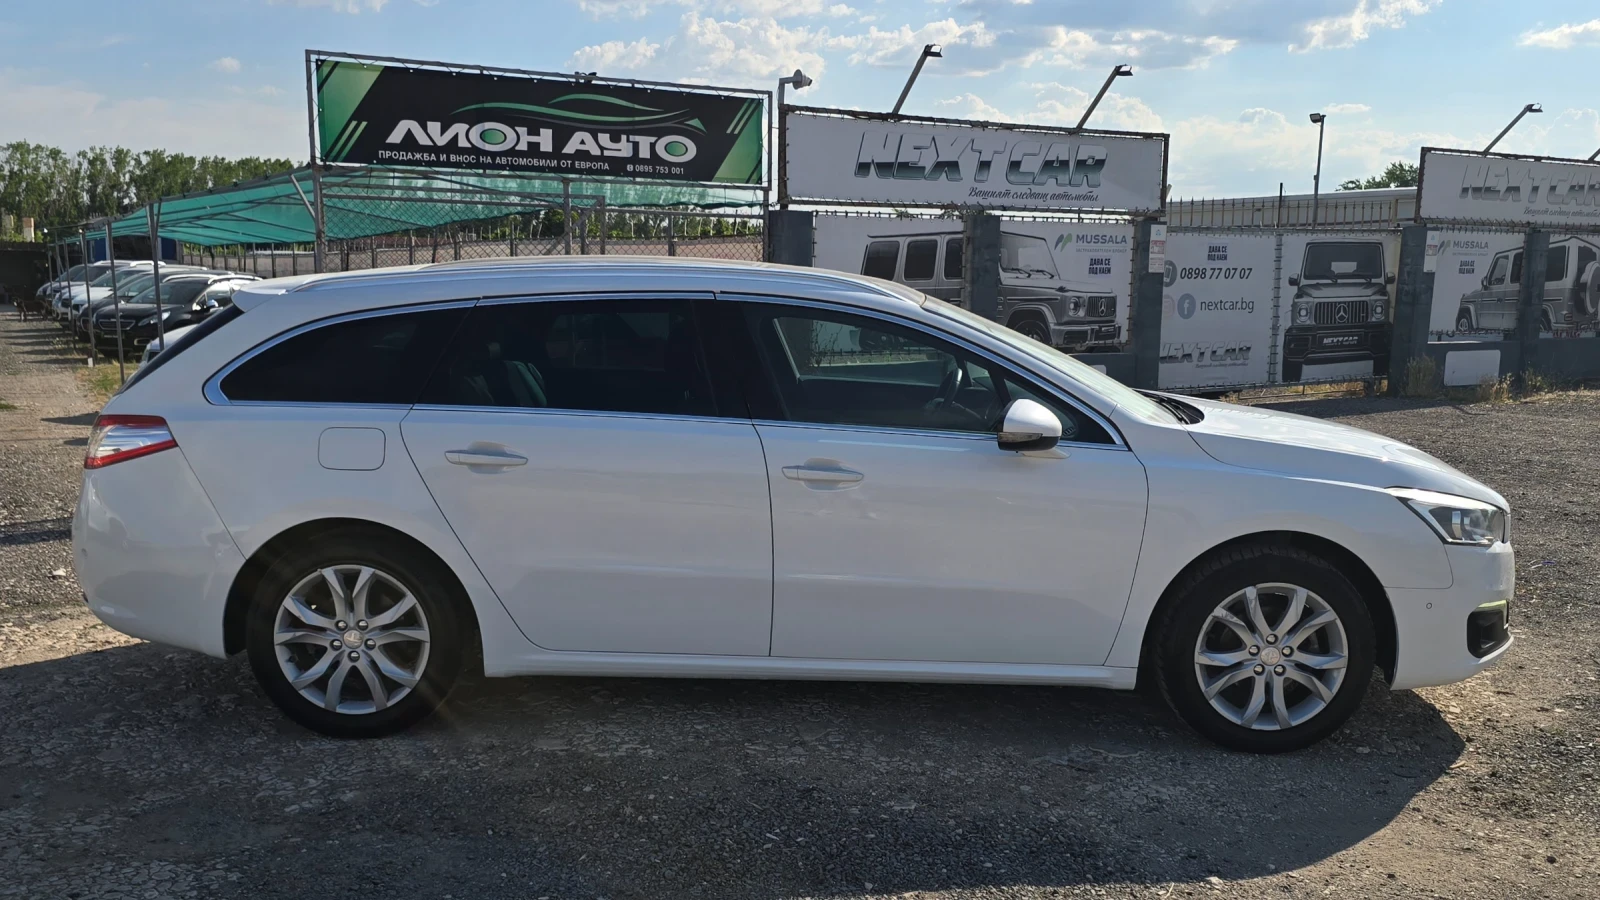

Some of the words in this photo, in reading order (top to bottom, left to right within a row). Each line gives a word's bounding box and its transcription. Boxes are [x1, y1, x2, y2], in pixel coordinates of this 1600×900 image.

[385, 119, 553, 153] ЛИОН
[561, 131, 698, 163] АУТО
[378, 150, 437, 162] ПРОДАЖБА
[440, 153, 447, 162] И
[450, 153, 477, 164] ВНОС
[479, 155, 492, 165] НА
[495, 156, 558, 168] АВТОМОБИЛИ
[560, 159, 572, 168] ОТ
[575, 161, 610, 171] ЕВРОПА
[635, 165, 653, 173] 0895
[656, 166, 669, 174] 753
[671, 167, 684, 175] 001
[1076, 234, 1127, 244] MUSSALA
[1208, 245, 1220, 253] ДАВА
[1221, 245, 1227, 253] СЕ
[1452, 240, 1489, 249] MUSSALA
[1089, 258, 1103, 266] ДАВА
[1104, 258, 1111, 266] СЕ
[1088, 267, 1098, 275] ПОД
[1099, 267, 1111, 275] НАЕМ
[1180, 267, 1207, 279] 0898
[1209, 267, 1223, 279] 77
[1224, 267, 1238, 279] 07
[1239, 267, 1253, 279] 07
[1200, 297, 1254, 313] nextcar.bg
